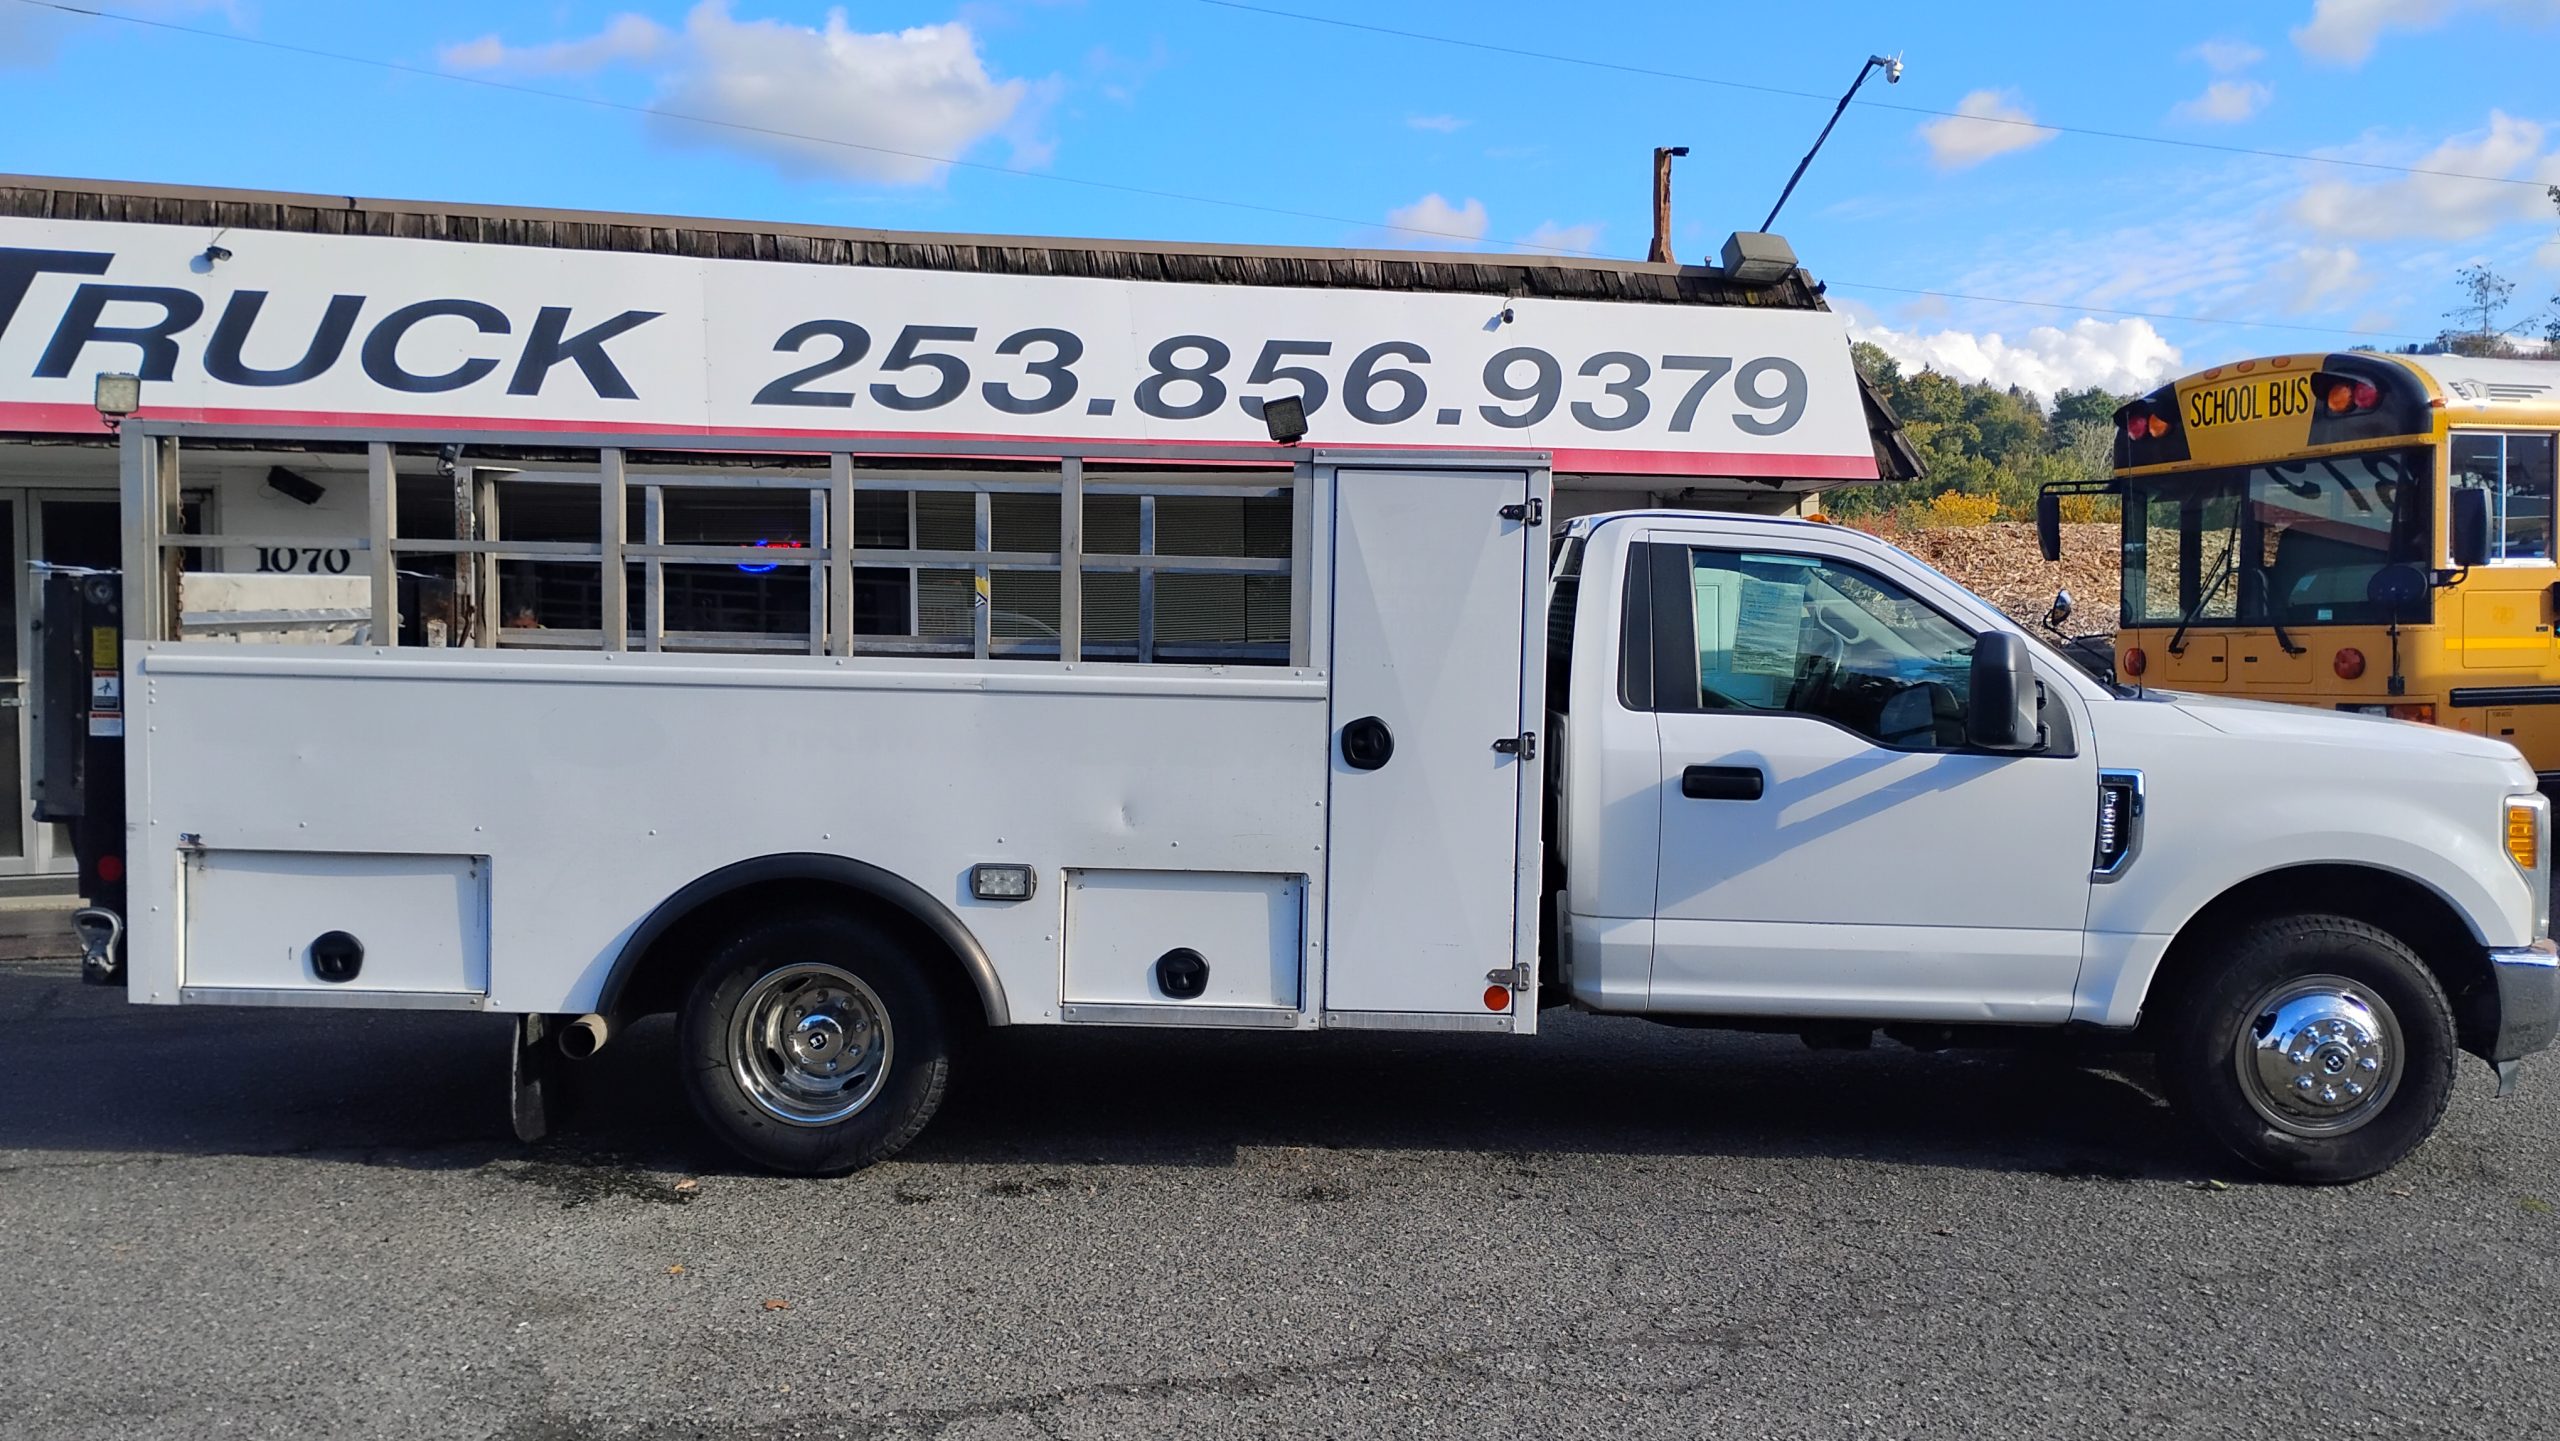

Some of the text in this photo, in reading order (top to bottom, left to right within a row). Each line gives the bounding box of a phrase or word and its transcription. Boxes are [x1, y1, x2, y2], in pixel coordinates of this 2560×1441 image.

[751, 319, 1808, 437] 253.856.9379
[2190, 377, 2309, 428] SCHOOL BUS
[256, 547, 351, 574] 1070
